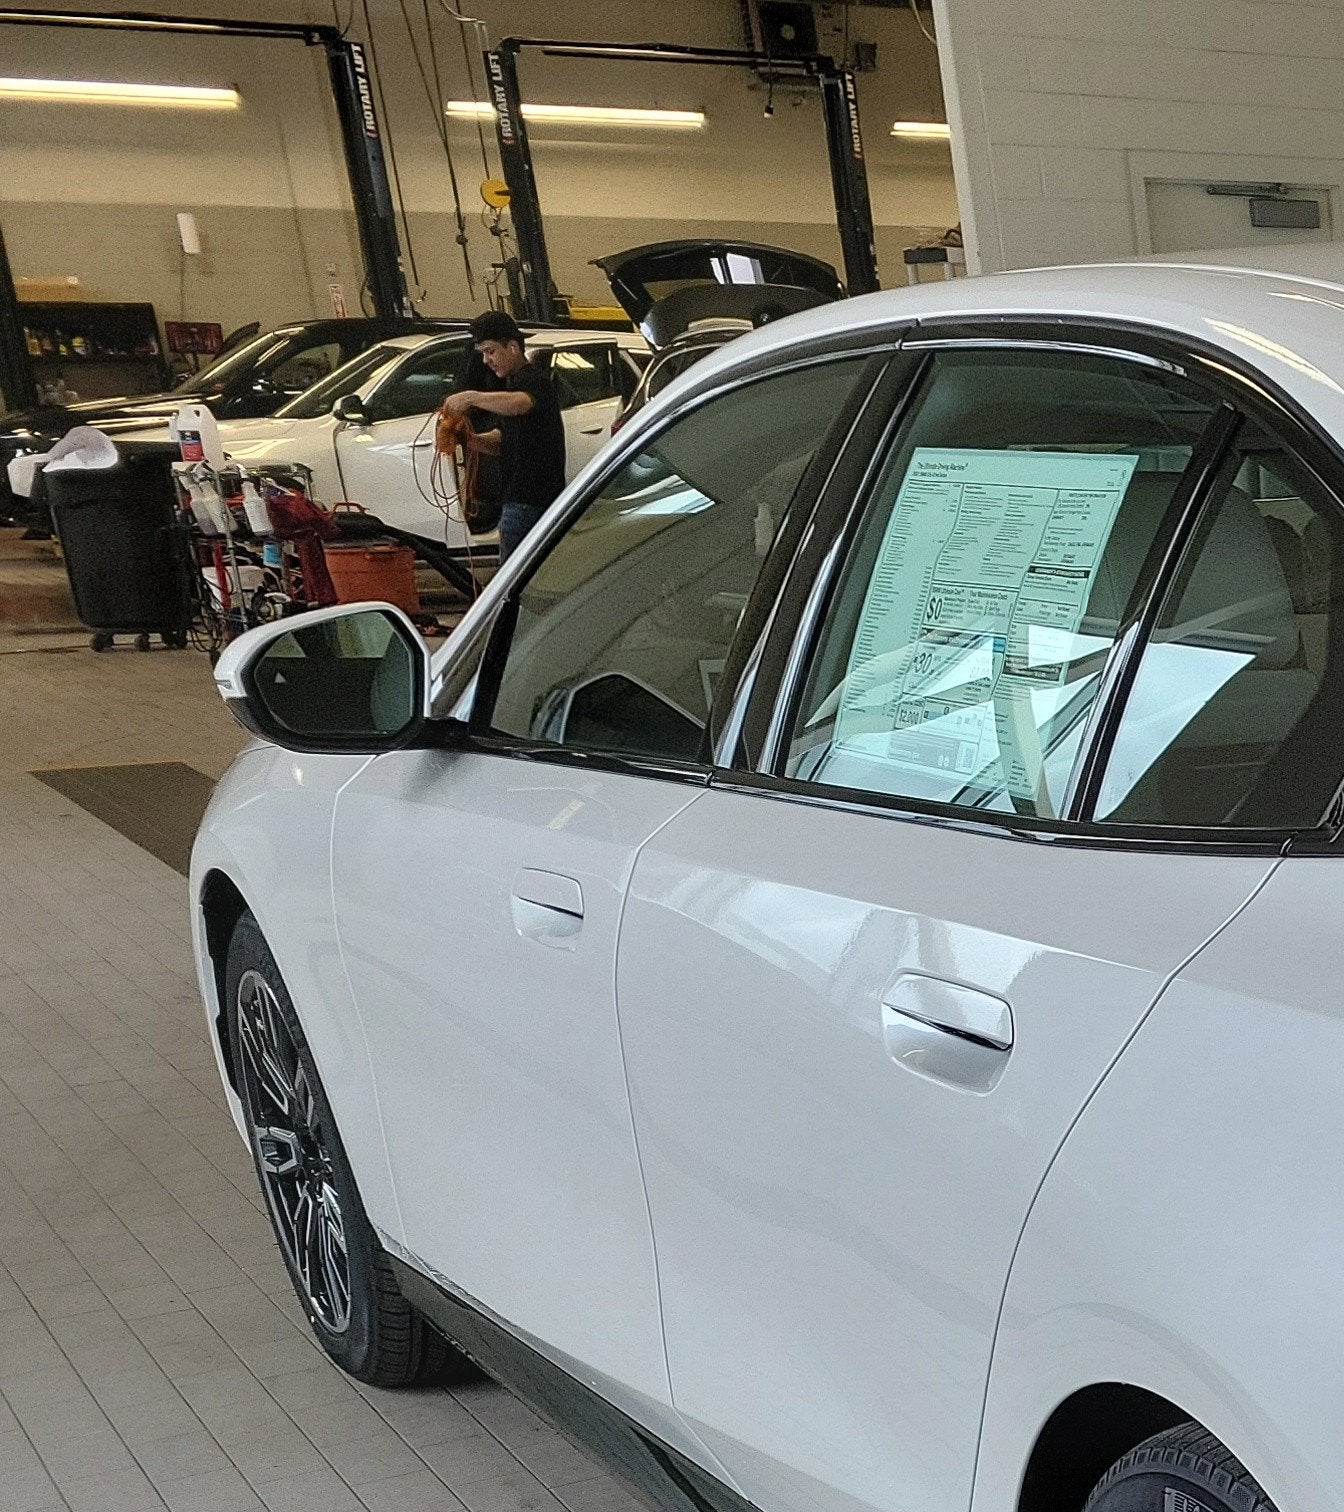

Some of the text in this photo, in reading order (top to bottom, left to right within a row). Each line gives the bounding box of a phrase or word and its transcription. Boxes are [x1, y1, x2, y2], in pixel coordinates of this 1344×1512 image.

[350, 43, 376, 130] ROTARY LIFT
[487, 53, 514, 138] ROTARY LIFT
[844, 72, 862, 153] ROTARY LIFT
[926, 597, 943, 621] $0
